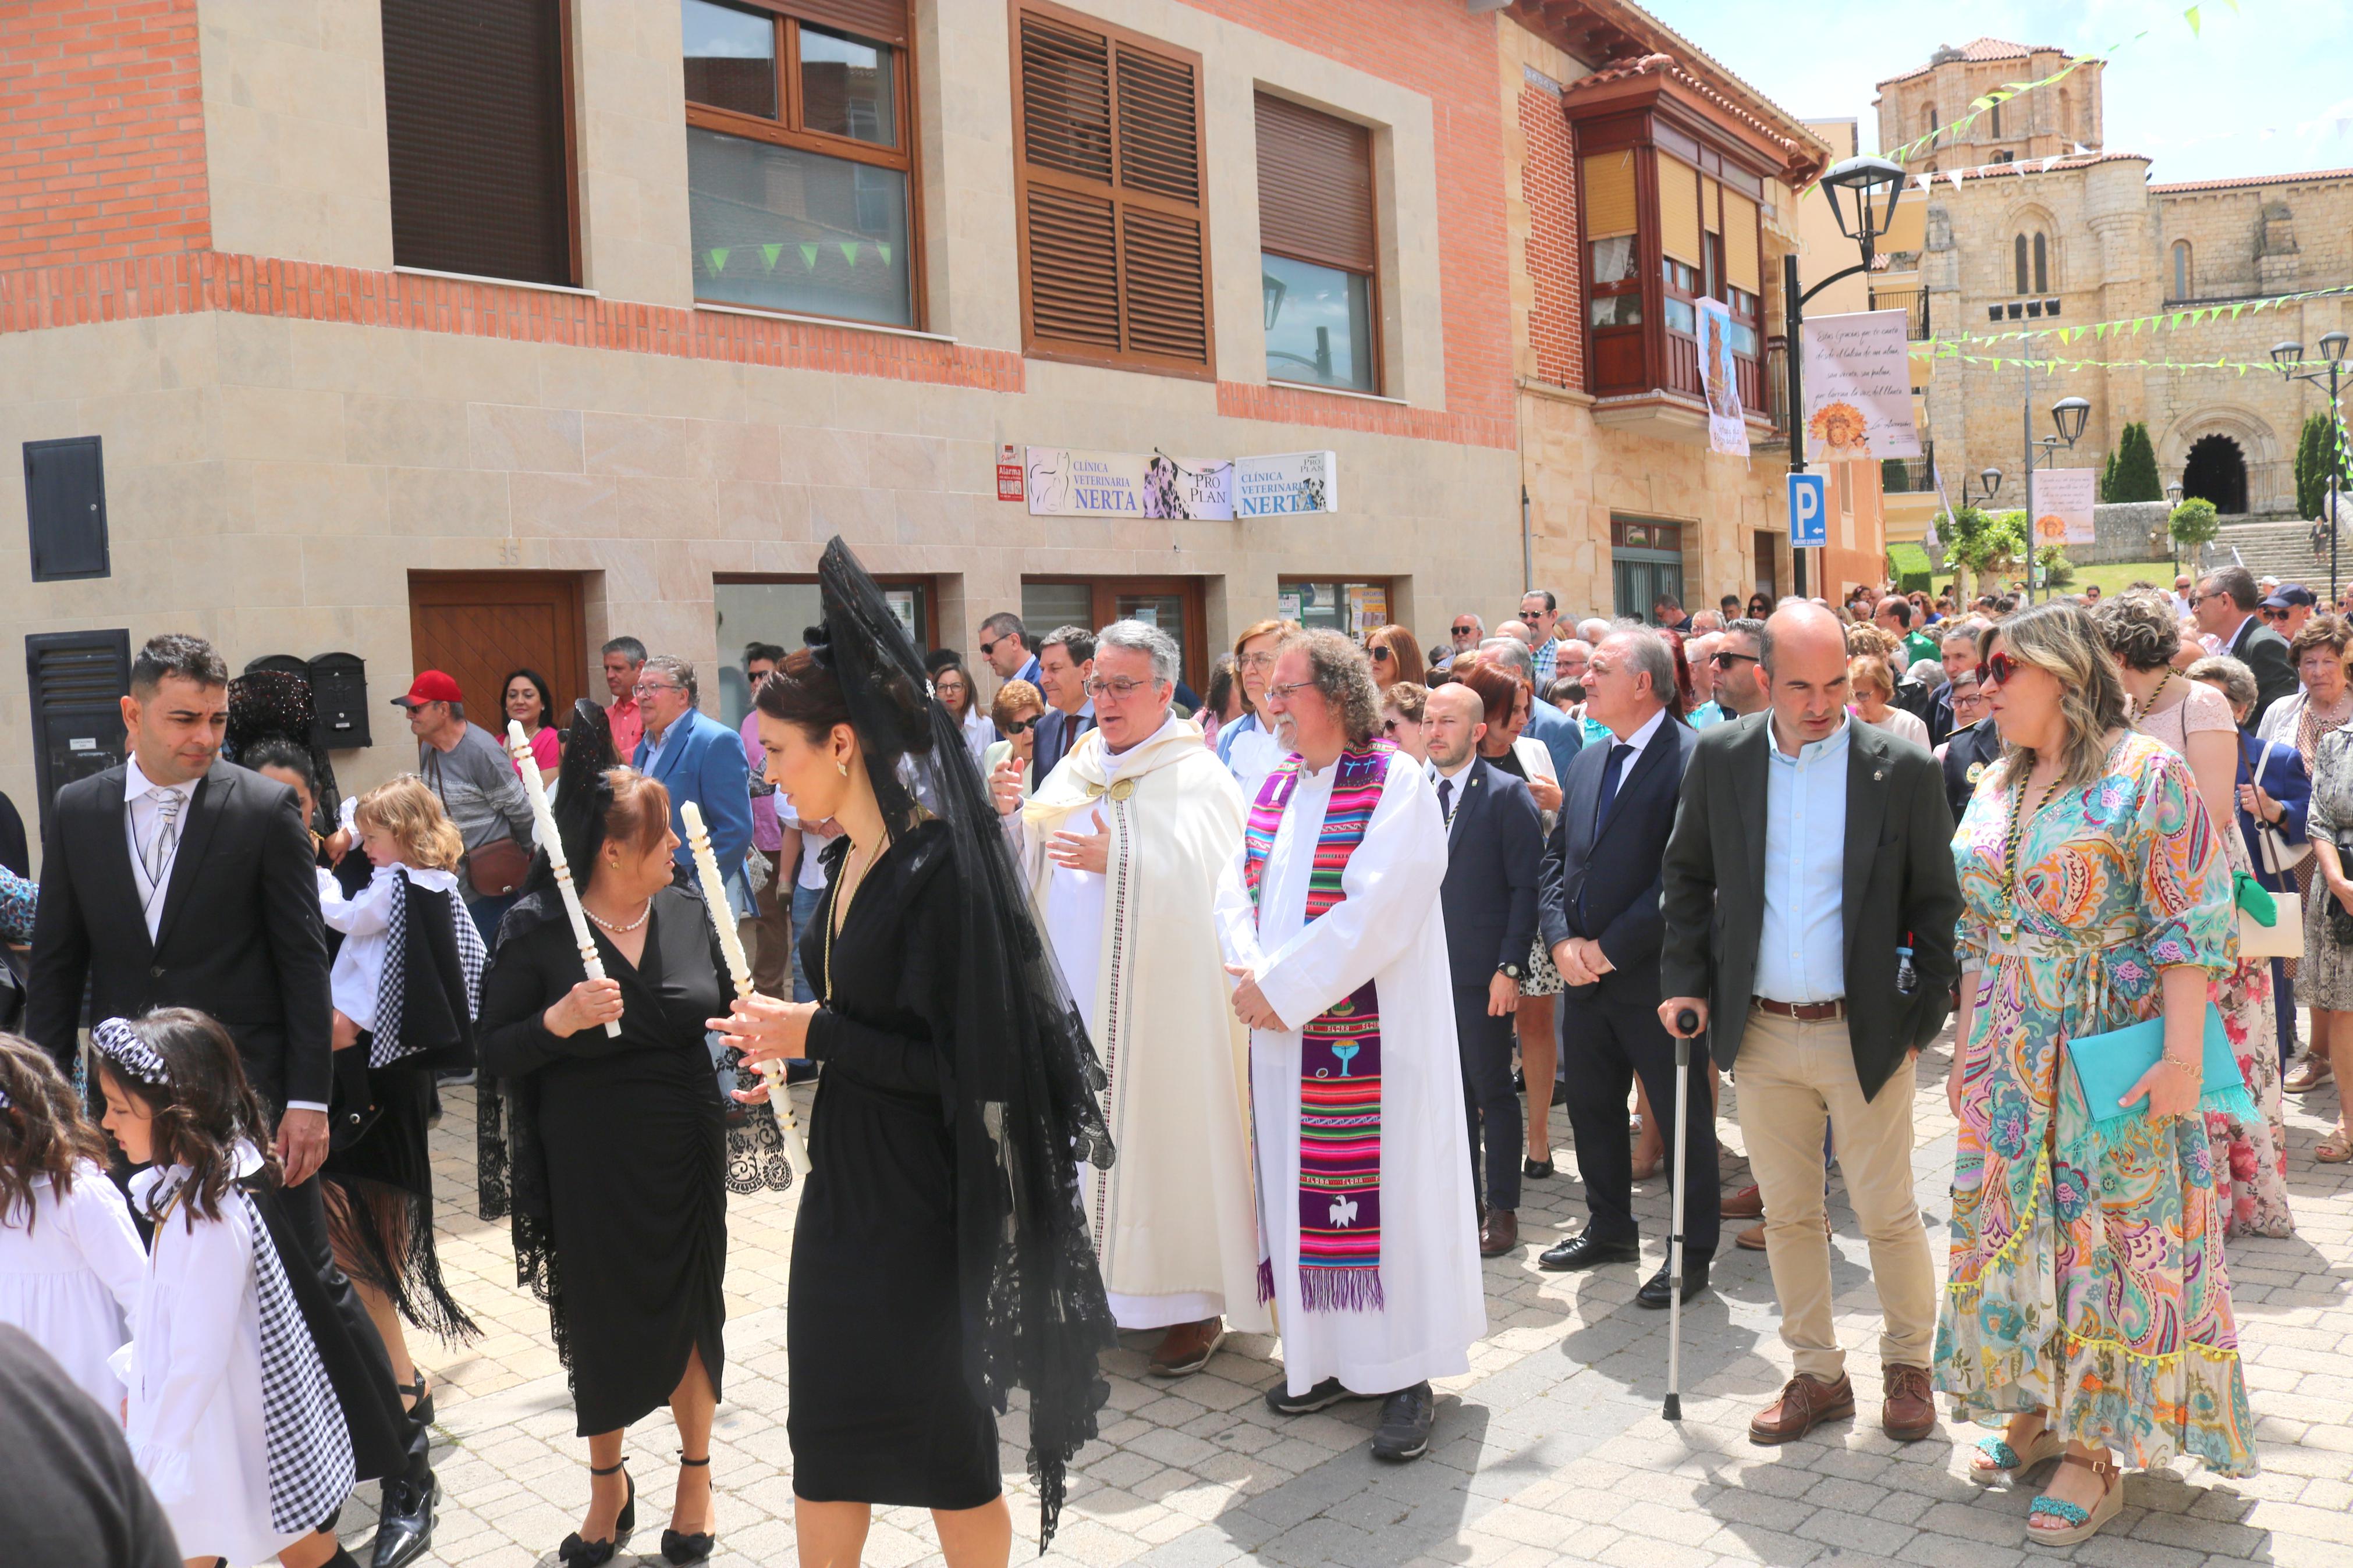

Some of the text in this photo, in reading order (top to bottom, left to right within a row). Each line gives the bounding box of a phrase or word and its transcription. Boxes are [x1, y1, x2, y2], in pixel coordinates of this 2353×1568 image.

[999, 466, 1021, 475] Alarma
[1073, 459, 1108, 473] CLÍNICA
[1074, 474, 1130, 488] VETERINARIA
[1196, 474, 1220, 489] PRO
[1241, 471, 1283, 483] CLÍNICA
[1190, 488, 1226, 503] PLAN
[1242, 482, 1310, 495] VETERINARIA
[1075, 488, 1138, 510] NERTA
[1242, 493, 1316, 515] NERTA
[1796, 482, 1818, 538] P
[498, 546, 521, 565] 35
